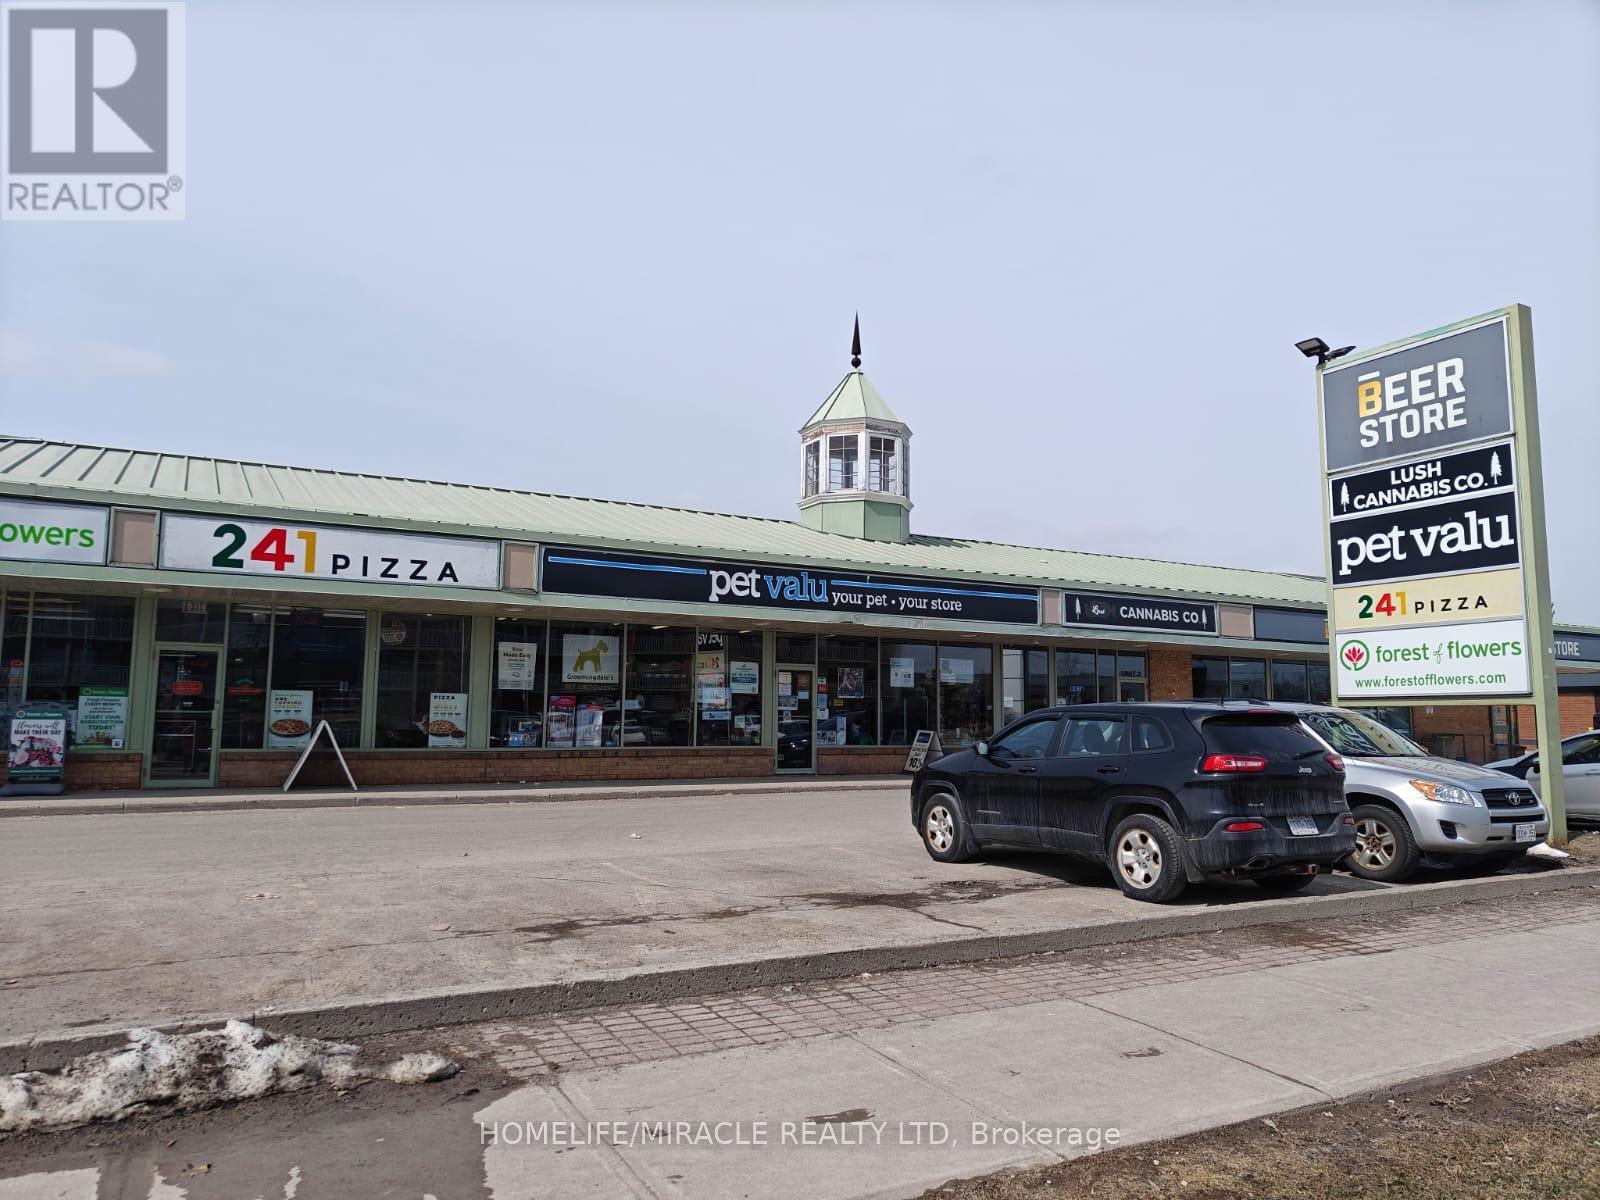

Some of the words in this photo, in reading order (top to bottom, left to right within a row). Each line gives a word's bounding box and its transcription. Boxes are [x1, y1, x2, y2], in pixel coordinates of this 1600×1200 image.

[1358, 357, 1466, 418] BEER
[1359, 396, 1467, 448] STORE
[1353, 478, 1451, 511] CANNABIS
[1454, 472, 1488, 491] CO.
[1390, 461, 1442, 485] LUSH
[212, 523, 317, 574] 241
[331, 553, 459, 583] PIZZA
[1337, 525, 1407, 576] pet
[1410, 511, 1514, 557] valu
[709, 569, 761, 601] pet
[764, 571, 829, 602] valu
[832, 591, 862, 606] your
[866, 594, 887, 608] pet
[899, 597, 928, 611] your
[931, 599, 963, 611] store
[1358, 591, 1407, 619] 241
[1414, 595, 1488, 614] PIZZA
[1120, 606, 1179, 622] CANNABIS
[1376, 642, 1429, 663] forest
[1447, 640, 1522, 660] flowers
[1355, 673, 1506, 688] www.forestofflowers.com
